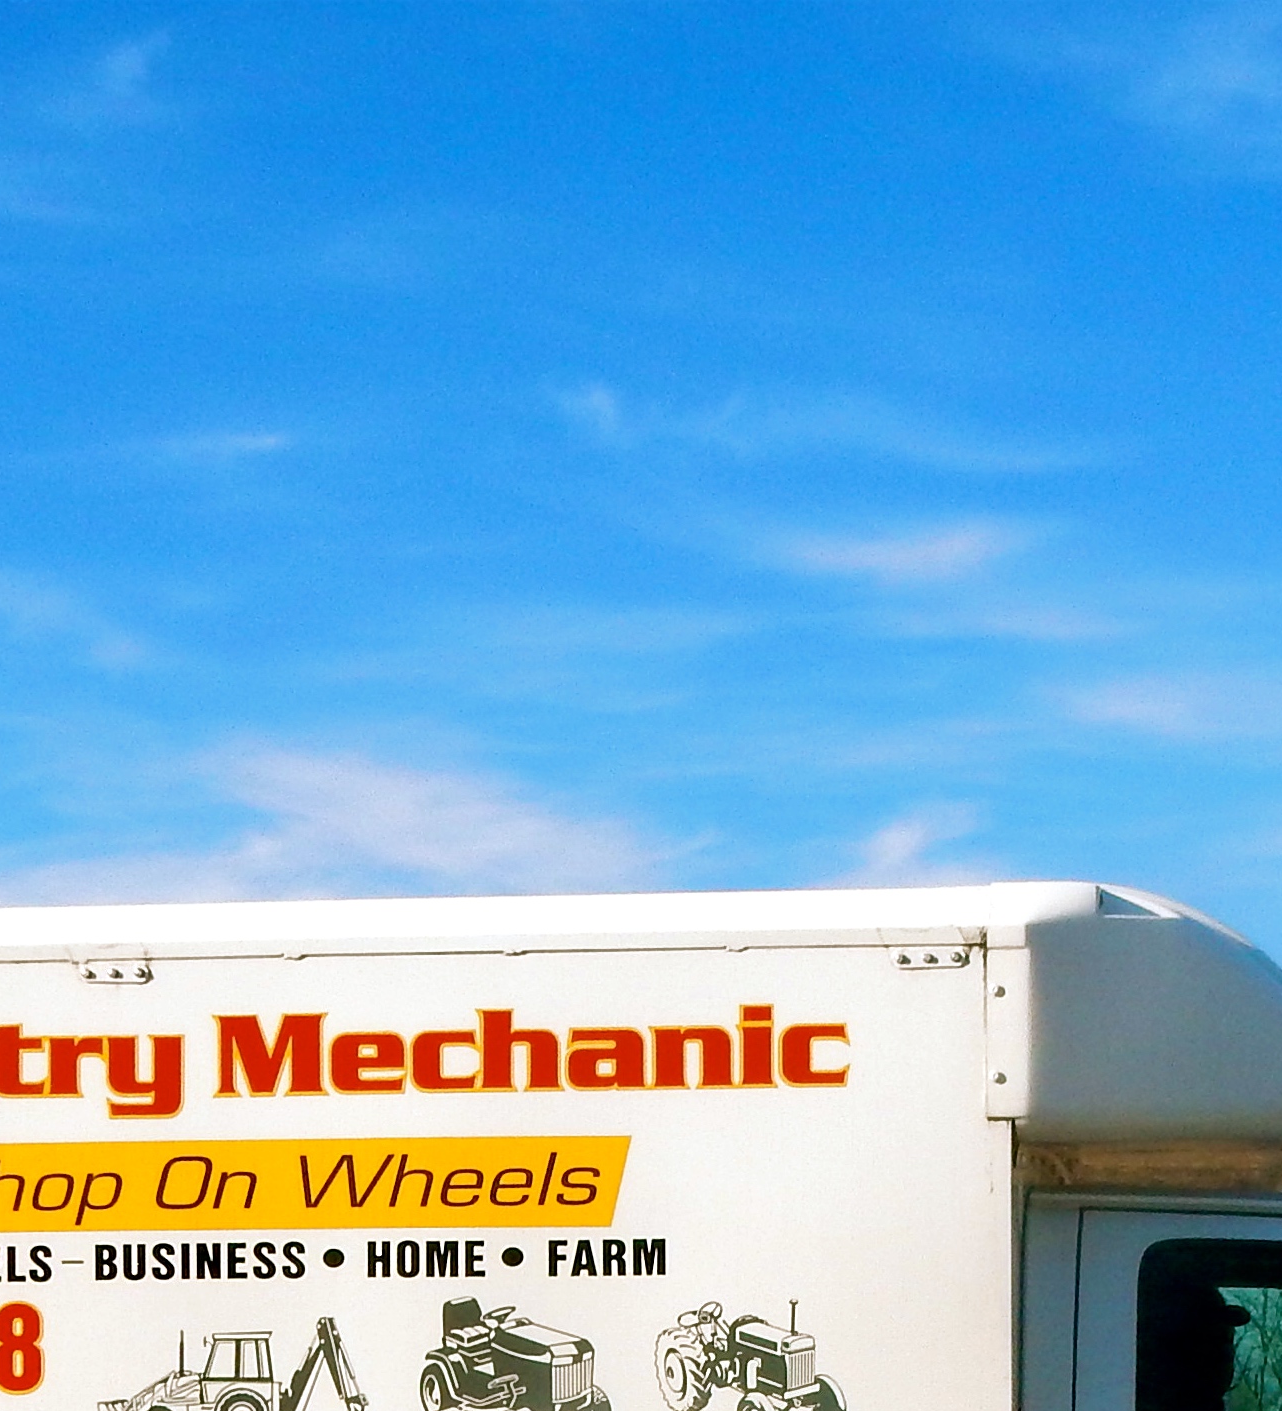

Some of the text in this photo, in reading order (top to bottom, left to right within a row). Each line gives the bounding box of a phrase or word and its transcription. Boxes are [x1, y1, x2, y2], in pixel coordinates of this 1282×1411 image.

[212, 1004, 849, 1098] Mechanic
[156, 1156, 257, 1209] On
[300, 1152, 600, 1208] Wheels
[368, 1240, 485, 1278] HOME
[549, 1239, 666, 1276] FARM
